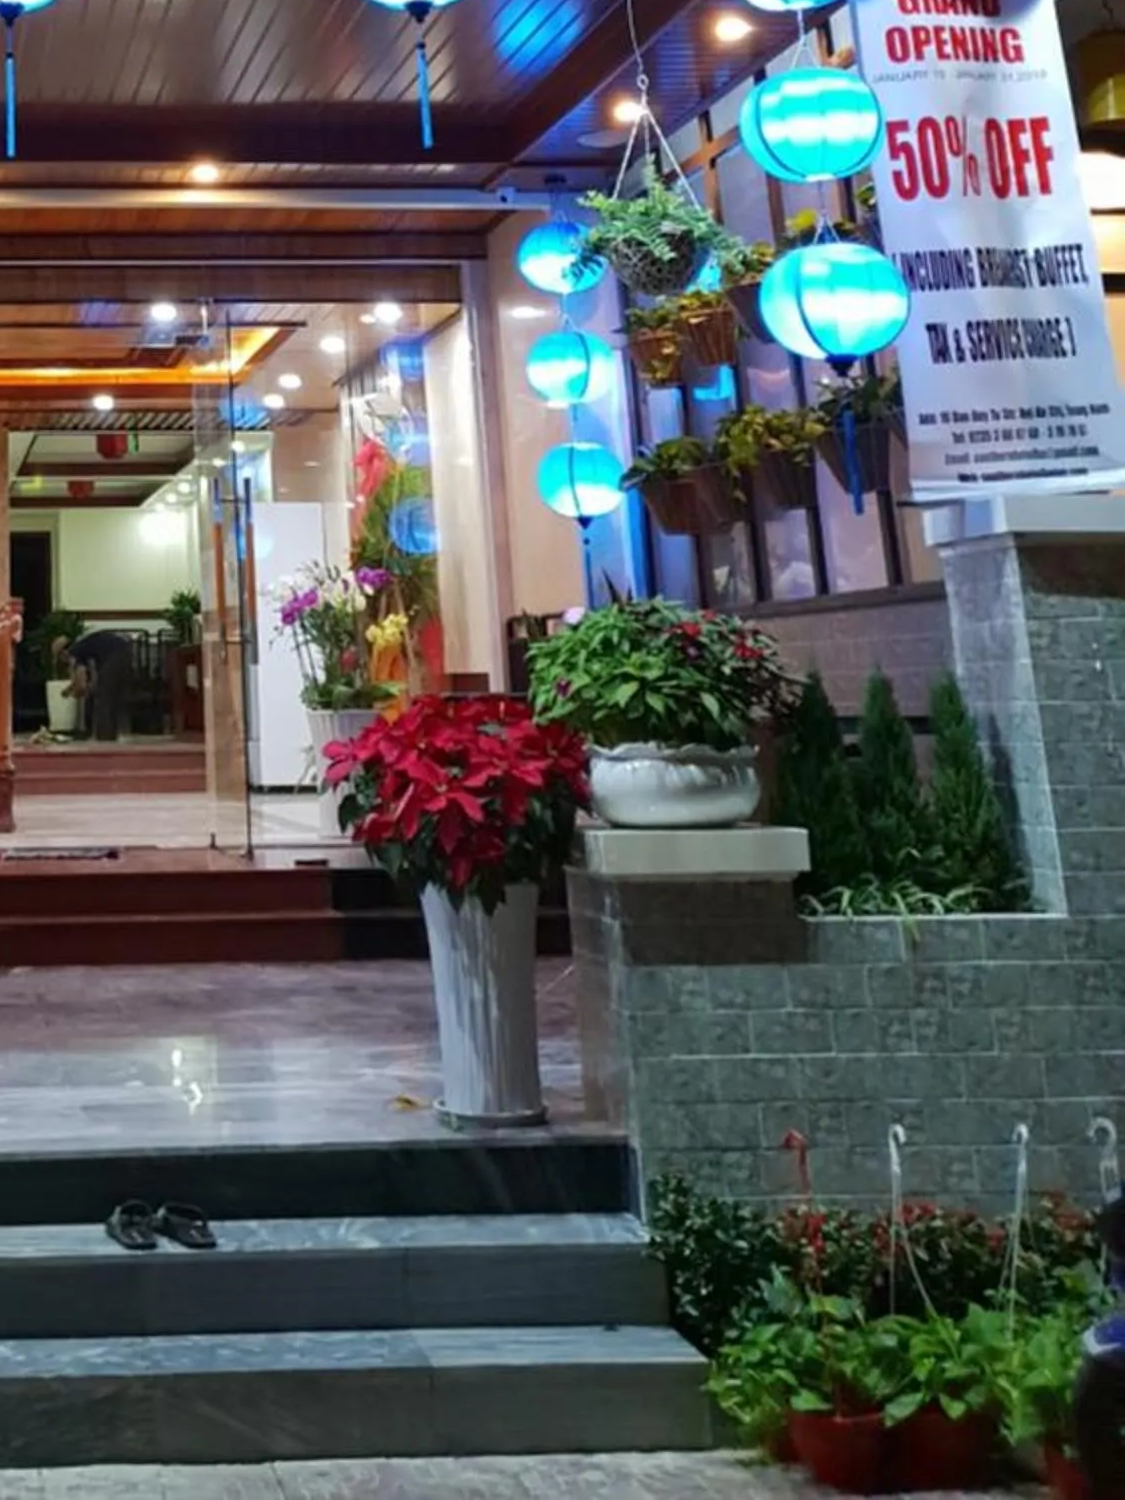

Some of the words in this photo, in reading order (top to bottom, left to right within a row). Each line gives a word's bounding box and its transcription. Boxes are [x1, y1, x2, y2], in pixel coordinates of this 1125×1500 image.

[884, 24, 1026, 64] OPENING
[885, 115, 982, 201] 50%
[985, 115, 1054, 199] OFF
[966, 318, 1024, 362] SERVICE
